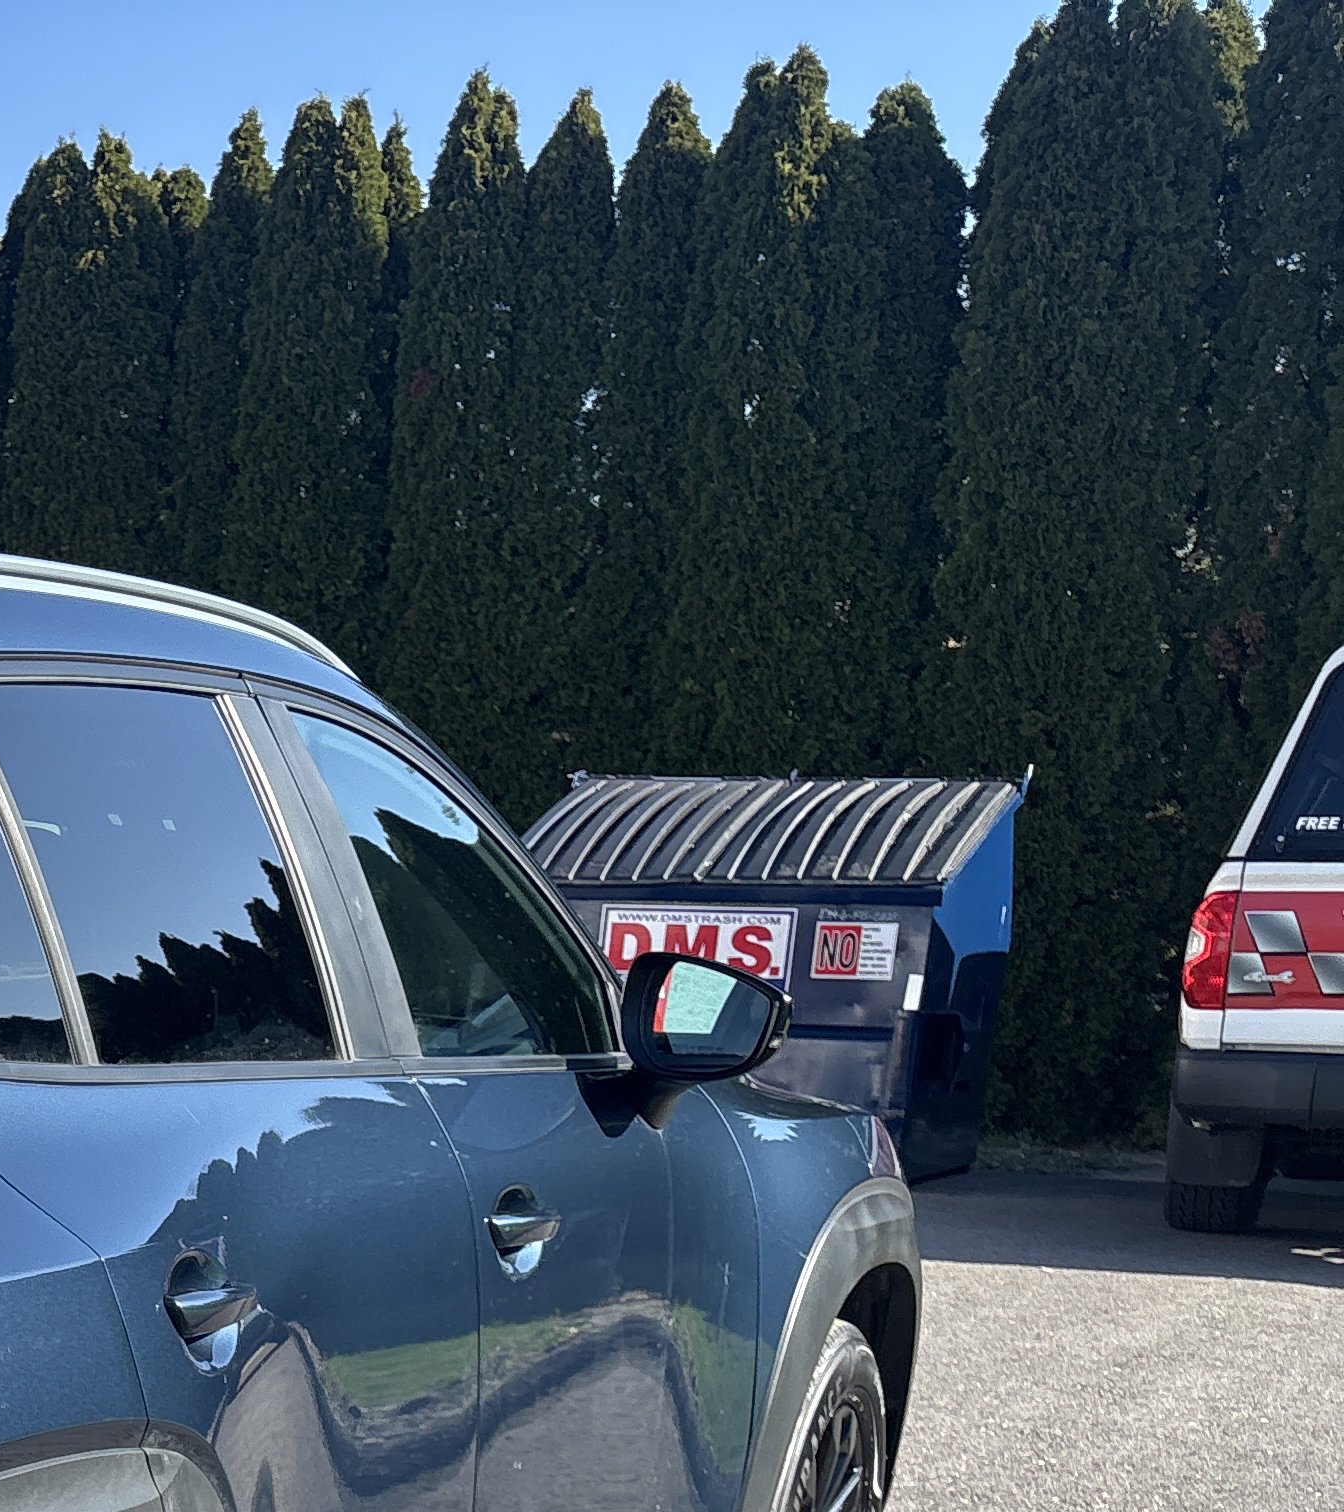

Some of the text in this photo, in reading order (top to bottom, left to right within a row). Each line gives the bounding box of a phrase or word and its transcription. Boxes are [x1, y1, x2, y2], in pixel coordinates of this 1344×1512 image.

[1295, 816, 1341, 831] FREE
[617, 912, 782, 926] WWW.DMSTRASH.COM
[818, 930, 858, 970] NO
